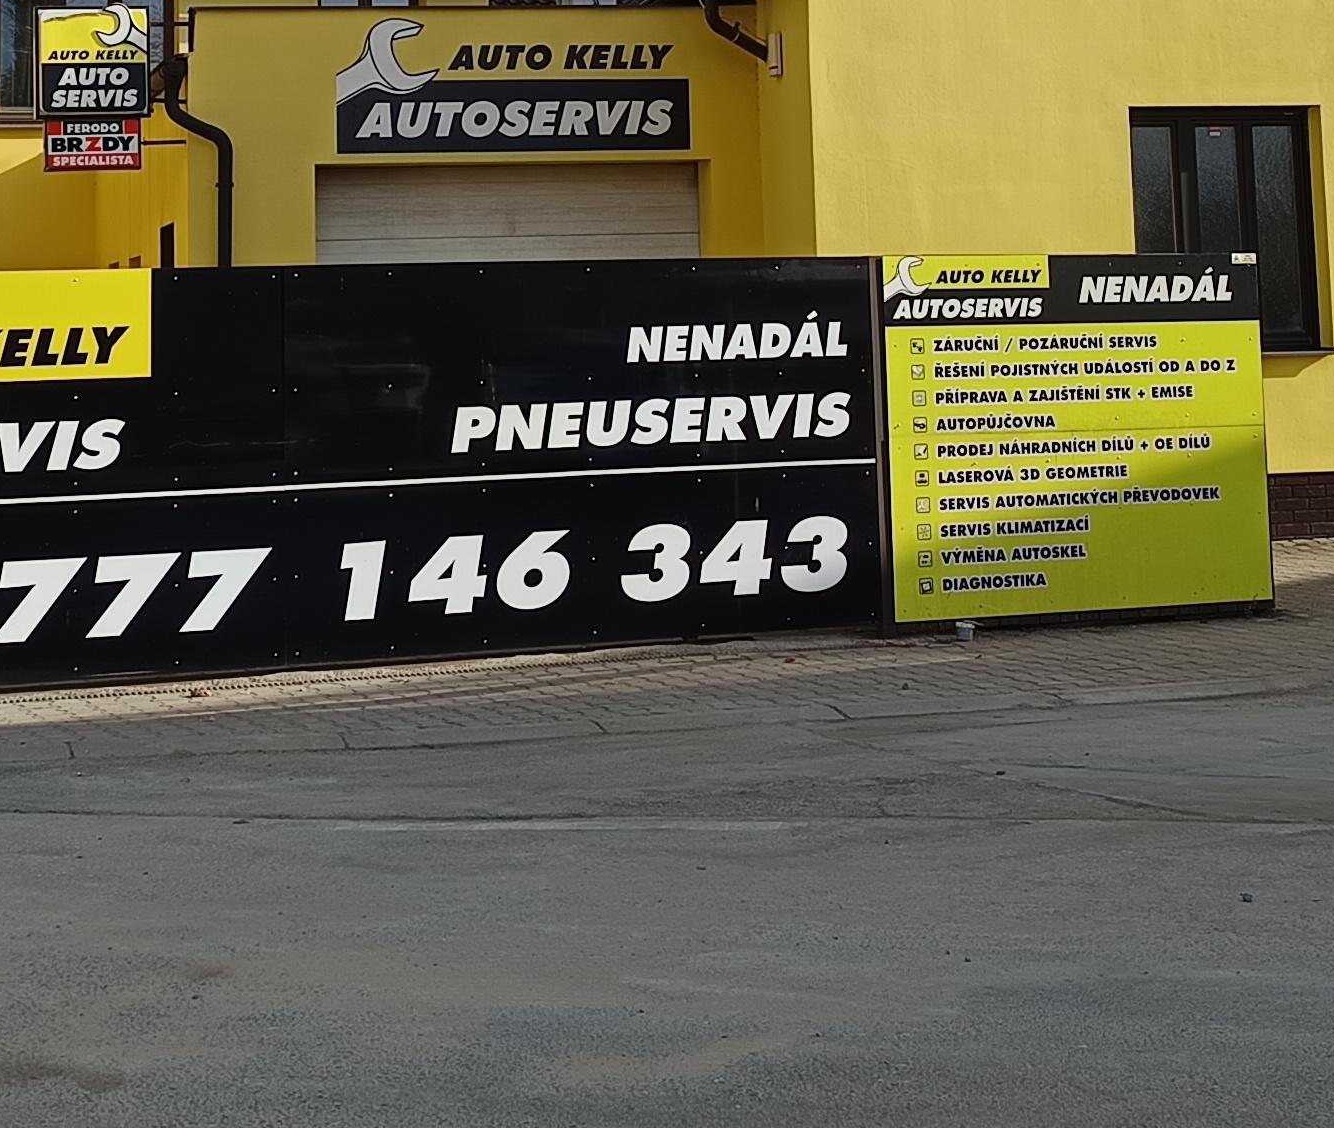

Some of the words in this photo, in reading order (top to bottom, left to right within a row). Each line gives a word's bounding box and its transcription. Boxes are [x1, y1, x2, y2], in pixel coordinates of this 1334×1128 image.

[48, 50, 89, 60] AUTO
[95, 50, 138, 60] KELLY
[447, 44, 553, 71] AUTO
[563, 44, 673, 70] KELLY
[58, 67, 129, 86] AUTO
[51, 89, 138, 108] SERVIS
[67, 123, 119, 134] FERODO
[355, 100, 673, 138] AUTOSERVIS
[51, 136, 134, 153] BRZDY
[53, 155, 134, 166] SPECIALISTA
[936, 270, 985, 284] AUTO
[991, 269, 1042, 283] KELLY
[1078, 267, 1233, 304] NENADÁL
[893, 297, 1043, 319] AUTOSERVIS
[626, 310, 849, 364] NENADÁL
[933, 335, 999, 352] ZÁRUČNÍ
[1005, 338, 1013, 352] /
[1019, 334, 1103, 350] POZÁRUČNÍ
[1109, 336, 1157, 348] SERVIS
[934, 362, 985, 378] ŘEŠENÍ
[991, 360, 1079, 376] POJISTNÝCH
[1084, 358, 1153, 374] UDÁLOSTÍ
[1159, 360, 1179, 372] OD
[1185, 360, 1195, 372] A
[1200, 360, 1221, 372] DO
[1227, 360, 1235, 371] Z
[935, 388, 1007, 404] PŘÍPRAVA
[1013, 390, 1023, 402] A
[1029, 385, 1099, 402] ZAJIŠTĚNÍ
[1105, 387, 1131, 400] STK
[1137, 389, 1145, 398] +
[1151, 386, 1193, 398] EMISE
[450, 391, 852, 454] PNEUSERVIS
[937, 414, 1055, 430] AUTOPŮJČOVNA
[937, 444, 993, 458] PRODEJ
[999, 437, 1096, 456] NÁHRADNÍCH
[1101, 436, 1134, 452] DÍLŮ
[1140, 440, 1149, 450] +
[1155, 438, 1173, 450] OE
[1179, 433, 1210, 448] DÍLŮ
[938, 466, 1014, 484] LASEROVÁ
[1020, 468, 1040, 480] 3D
[1046, 465, 1127, 480] GEOMETRIE
[939, 496, 990, 510] SERVIS
[995, 488, 1117, 508] AUTOMATICKÝCH
[1123, 487, 1220, 502] PŘEVODOVEK
[941, 523, 991, 538] SERVIS
[997, 515, 1089, 535] KLIMATIZACÍ
[941, 547, 1007, 564] VÝMĚNA
[1011, 545, 1087, 561] AUTOSKEL
[339, 529, 572, 622] 146
[620, 515, 849, 604] 343
[943, 574, 1047, 592] DIAGNOSTIKA
